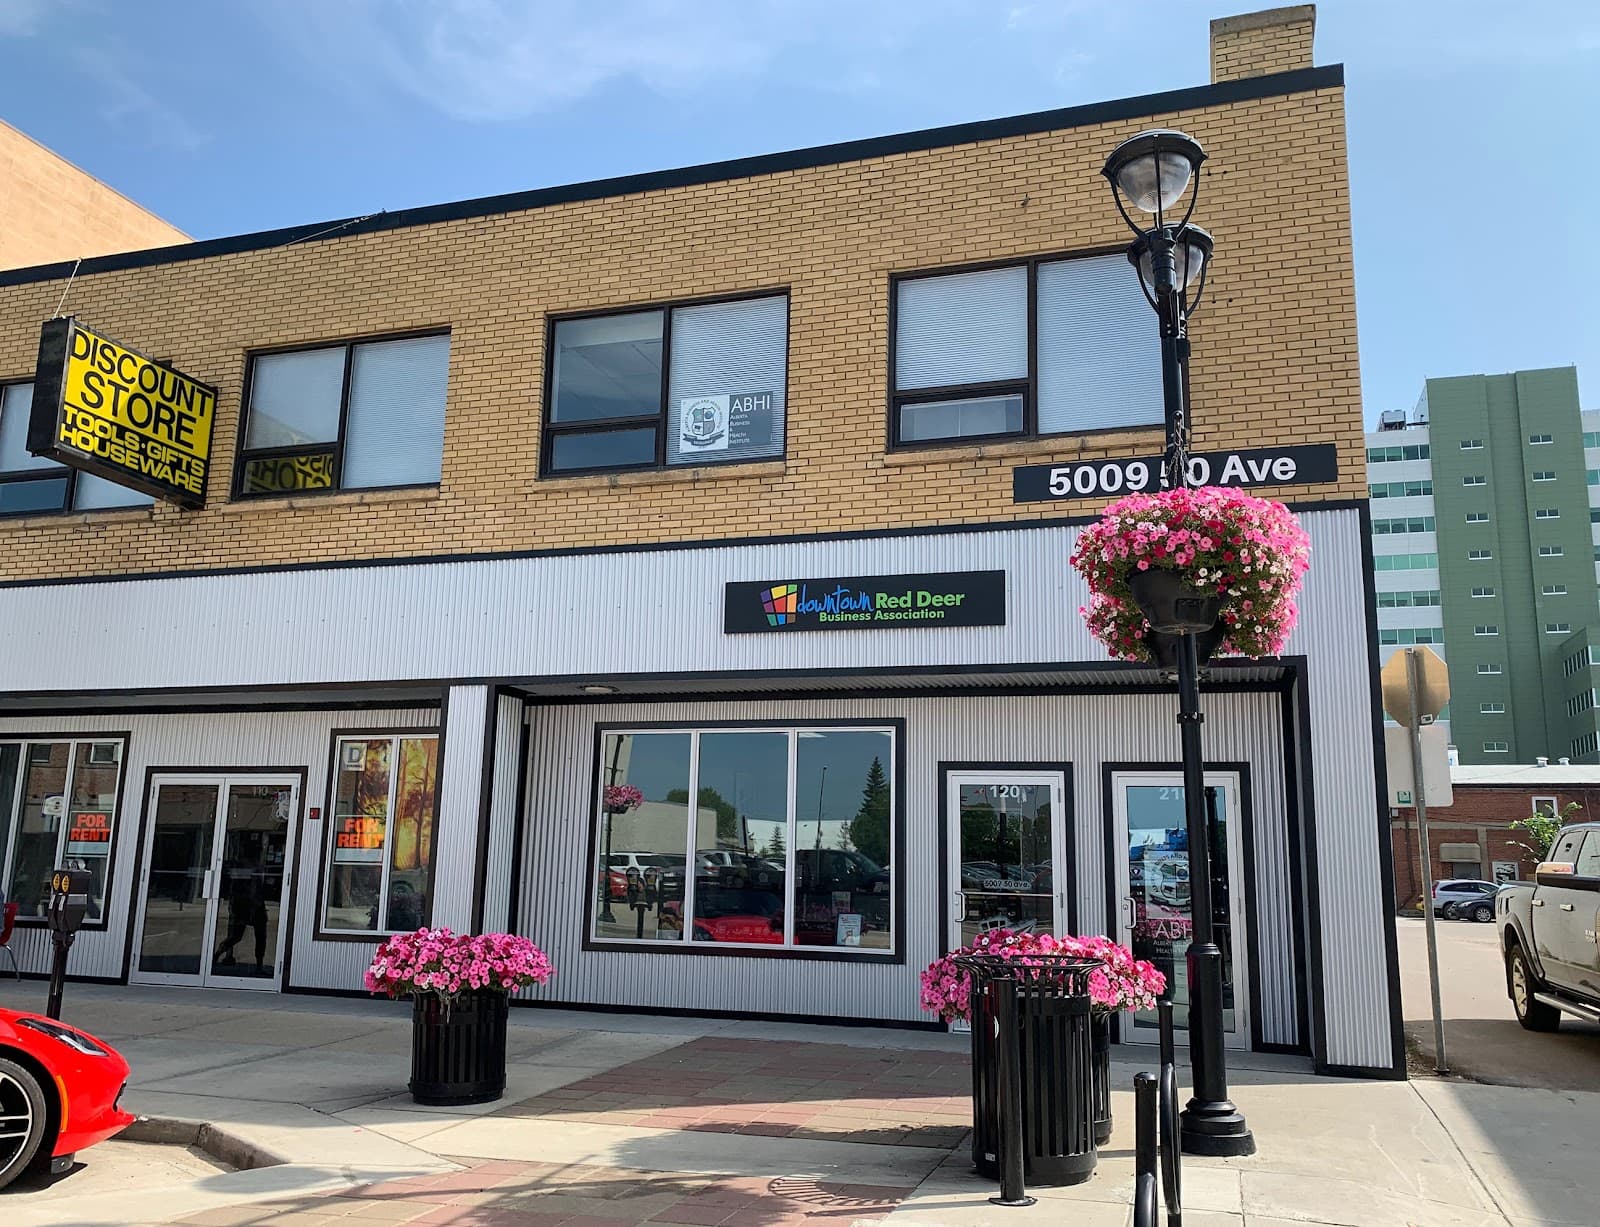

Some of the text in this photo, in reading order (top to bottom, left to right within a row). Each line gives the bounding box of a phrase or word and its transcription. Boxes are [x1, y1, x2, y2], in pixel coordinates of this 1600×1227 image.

[71, 327, 212, 417] DISCOUNT
[80, 371, 197, 450] STORE
[731, 395, 770, 413] ABHI
[60, 424, 203, 495] HOUSEWARE
[1049, 462, 1149, 496] 5009
[1219, 455, 1298, 484] Ave
[797, 583, 966, 615] downtown Red Deer
[819, 608, 945, 622] Business Association
[990, 785, 1020, 798] 120
[76, 814, 107, 827] FOR
[344, 817, 378, 832] FOR
[70, 828, 111, 841] RENT
[337, 833, 384, 848] RENT
[1155, 921, 1192, 939] ABH
